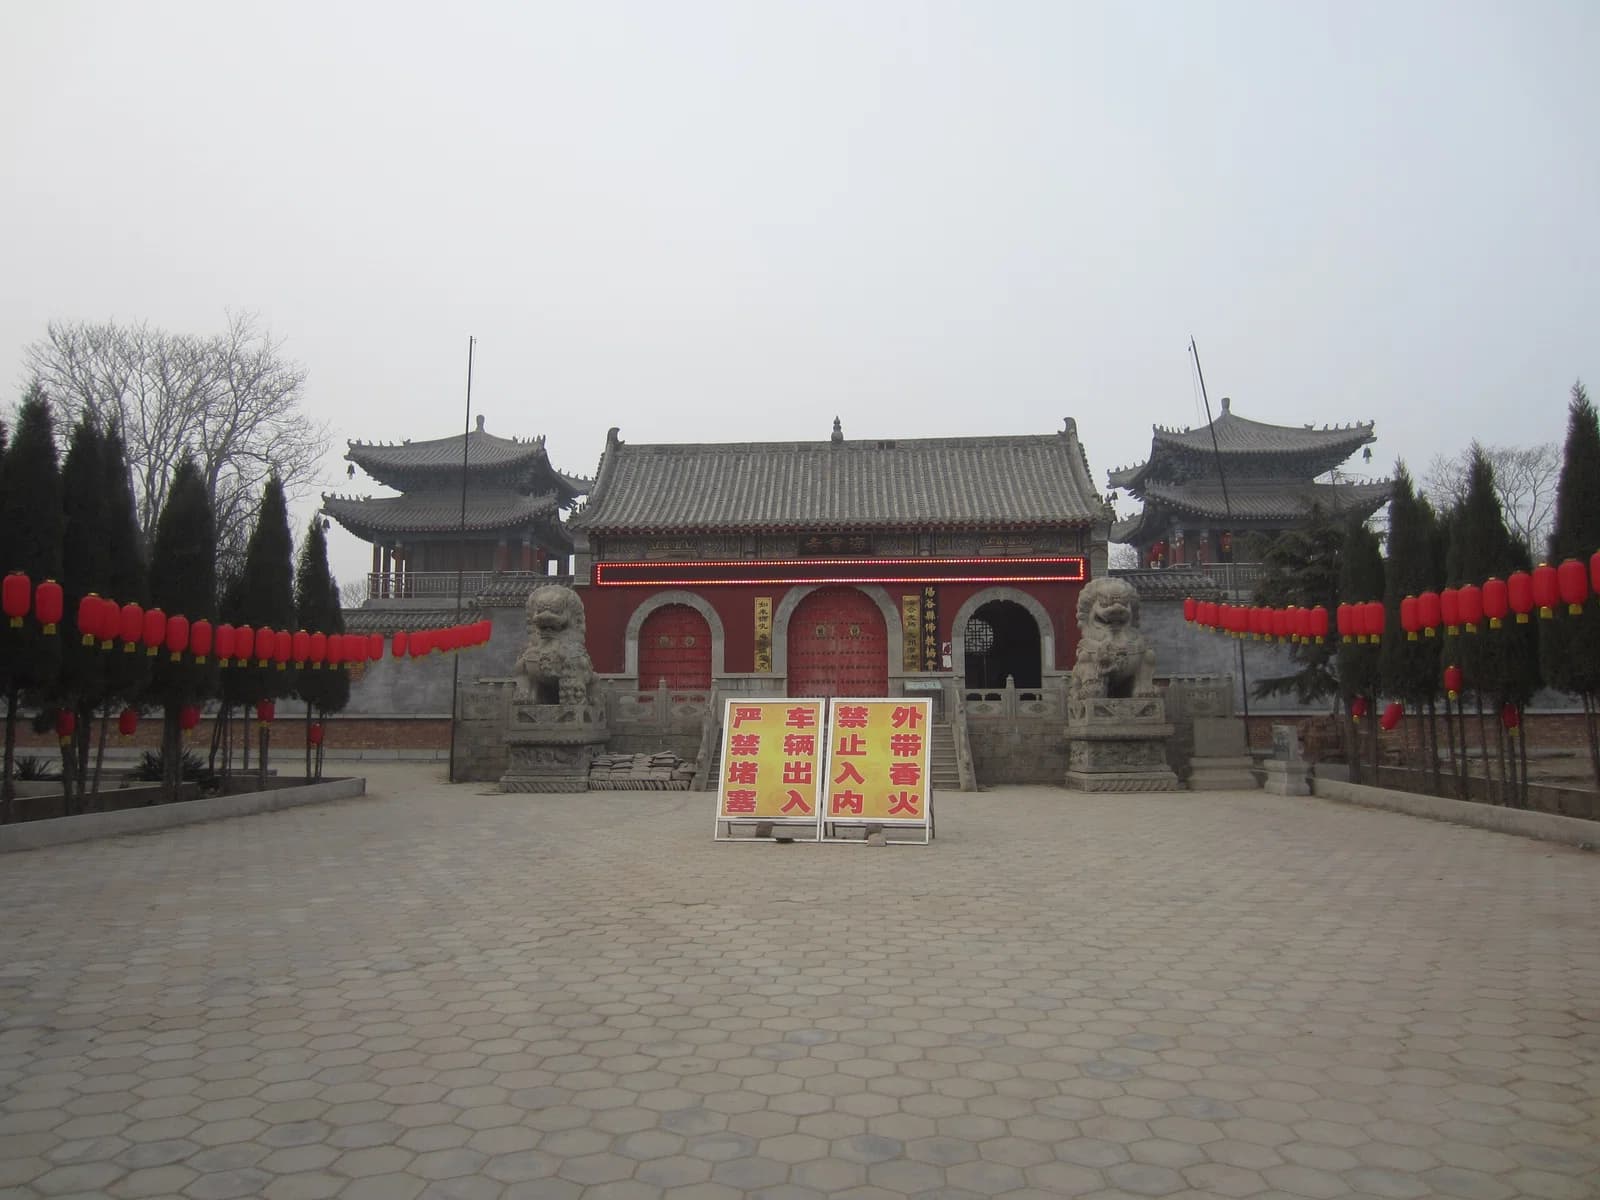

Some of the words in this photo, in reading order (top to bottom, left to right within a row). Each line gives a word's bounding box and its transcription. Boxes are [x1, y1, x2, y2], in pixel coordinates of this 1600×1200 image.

[727, 707, 761, 812] 严禁堵塞
[781, 708, 815, 813] 车辆出入
[832, 706, 868, 814] 禁止入内
[887, 706, 923, 815] 外带香火
